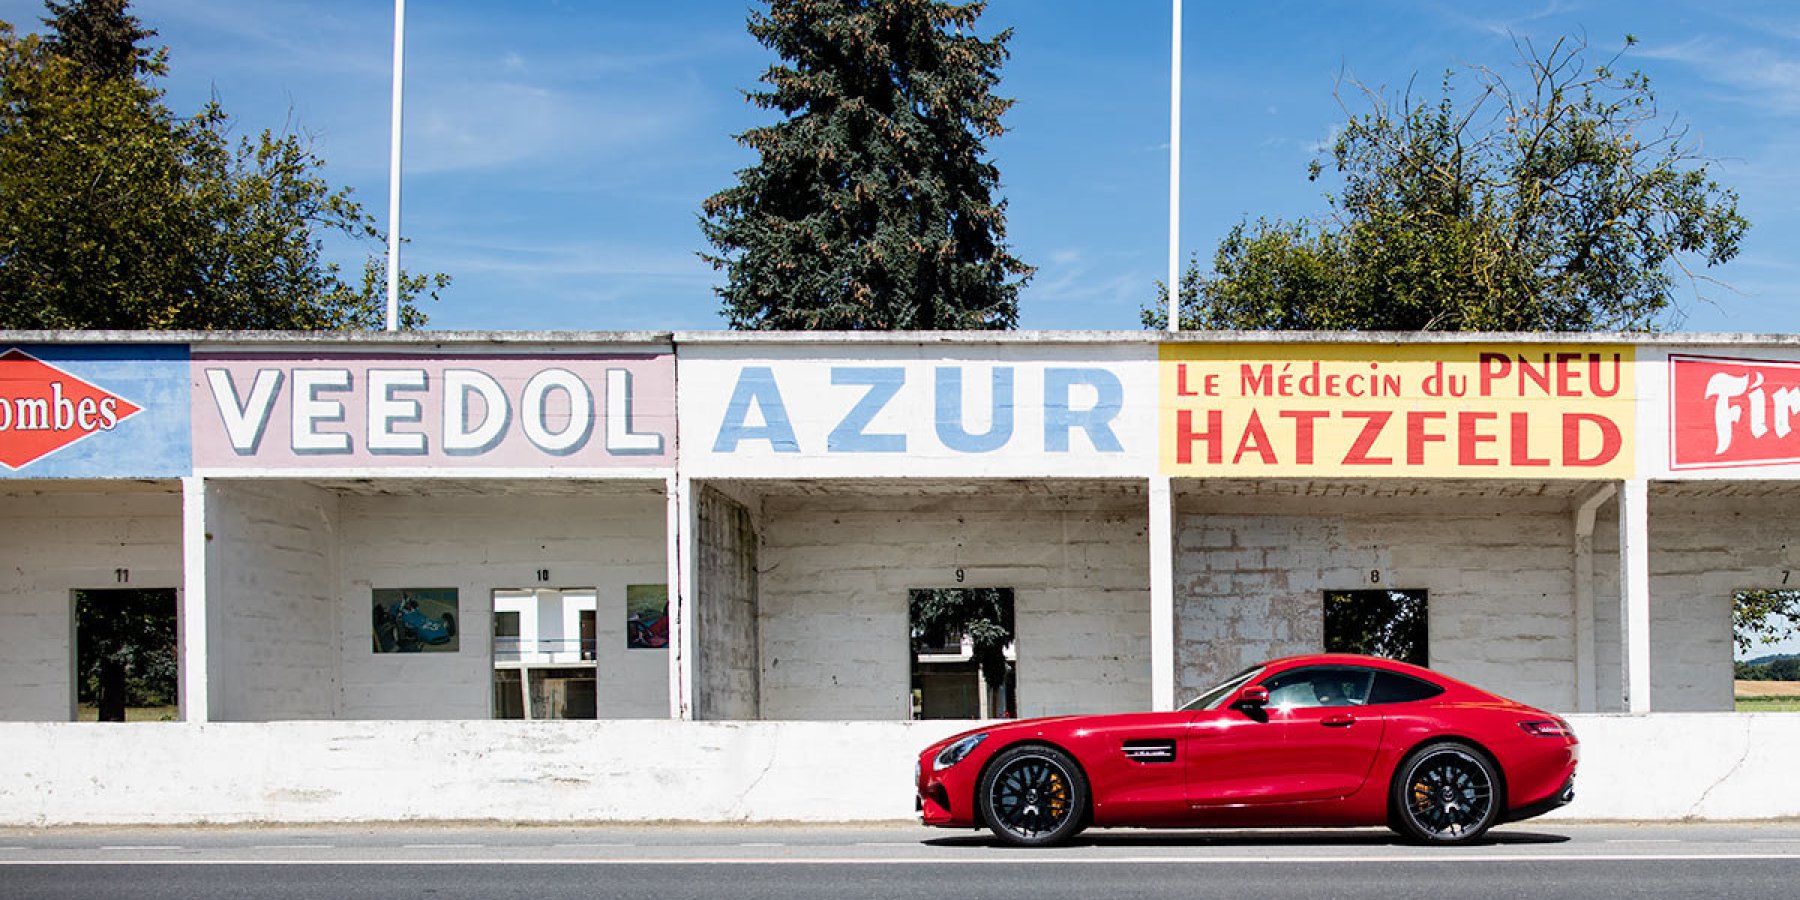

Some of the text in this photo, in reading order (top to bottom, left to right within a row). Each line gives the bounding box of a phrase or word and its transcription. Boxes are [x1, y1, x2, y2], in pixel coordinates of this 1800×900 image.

[1177, 363, 1220, 396] Le
[1421, 361, 1467, 397] du
[1480, 352, 1621, 397] PNEU
[205, 368, 665, 456] VEEDOL
[711, 366, 1126, 453] AZUR
[1176, 408, 1623, 467] HATZFELD
[115, 568, 129, 582] 11
[536, 569, 550, 581] 10
[956, 569, 964, 582] 9
[1370, 569, 1380, 583] 8
[1781, 570, 1790, 584] 7
